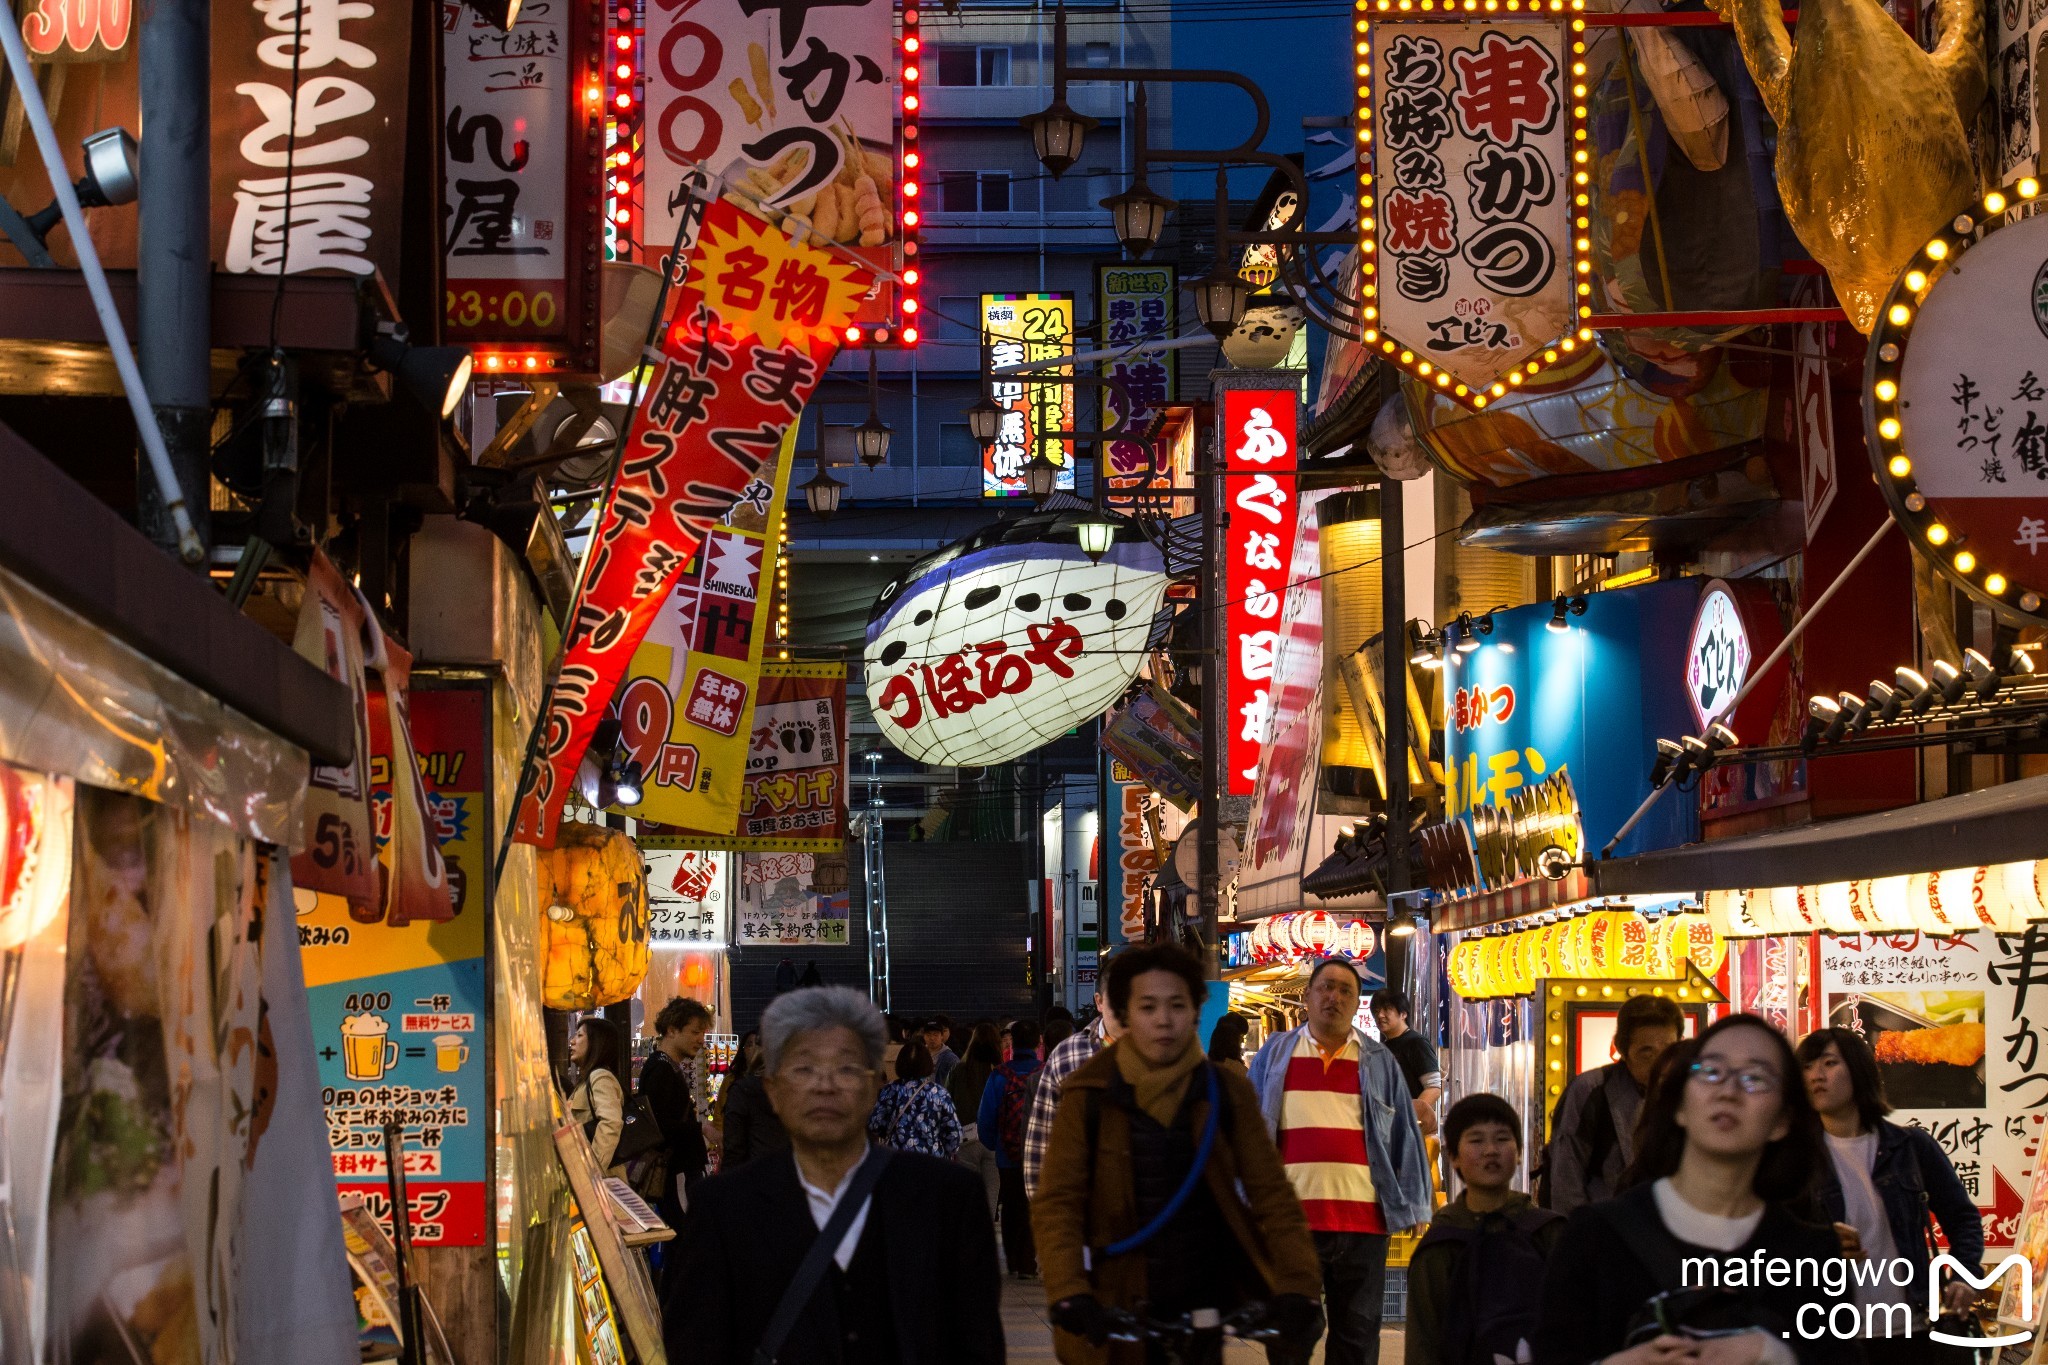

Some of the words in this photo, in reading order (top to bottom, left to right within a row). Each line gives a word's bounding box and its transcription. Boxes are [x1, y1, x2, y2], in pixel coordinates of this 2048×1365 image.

[468, 29, 559, 56] どて焼き
[489, 62, 544, 87] 一品
[738, 0, 884, 207] かつ
[1380, 34, 1459, 302] お好み焼き
[1449, 30, 1559, 297] 串かつ
[716, 243, 833, 328] 名物
[1106, 271, 1168, 295] 新世界
[2011, 370, 2048, 402] 名
[1951, 373, 1982, 453] 串かつ
[2013, 516, 2048, 557] 年
[699, 673, 741, 703] 年中
[879, 616, 1084, 729] づぼらや
[690, 698, 735, 728] 無休
[610, 676, 699, 791] 9円
[815, 700, 835, 762] 商売繁盛
[748, 810, 837, 836] 毎度おおきに
[743, 853, 815, 885] 大阪名物
[742, 922, 845, 939] 宴会予約受付中
[344, 991, 392, 1012] 400
[415, 994, 451, 1012] 一杯
[1987, 926, 2048, 1109] 串かつ
[404, 1014, 473, 1032] 無料サービス
[330, 1128, 443, 1148] ジョッ一杯
